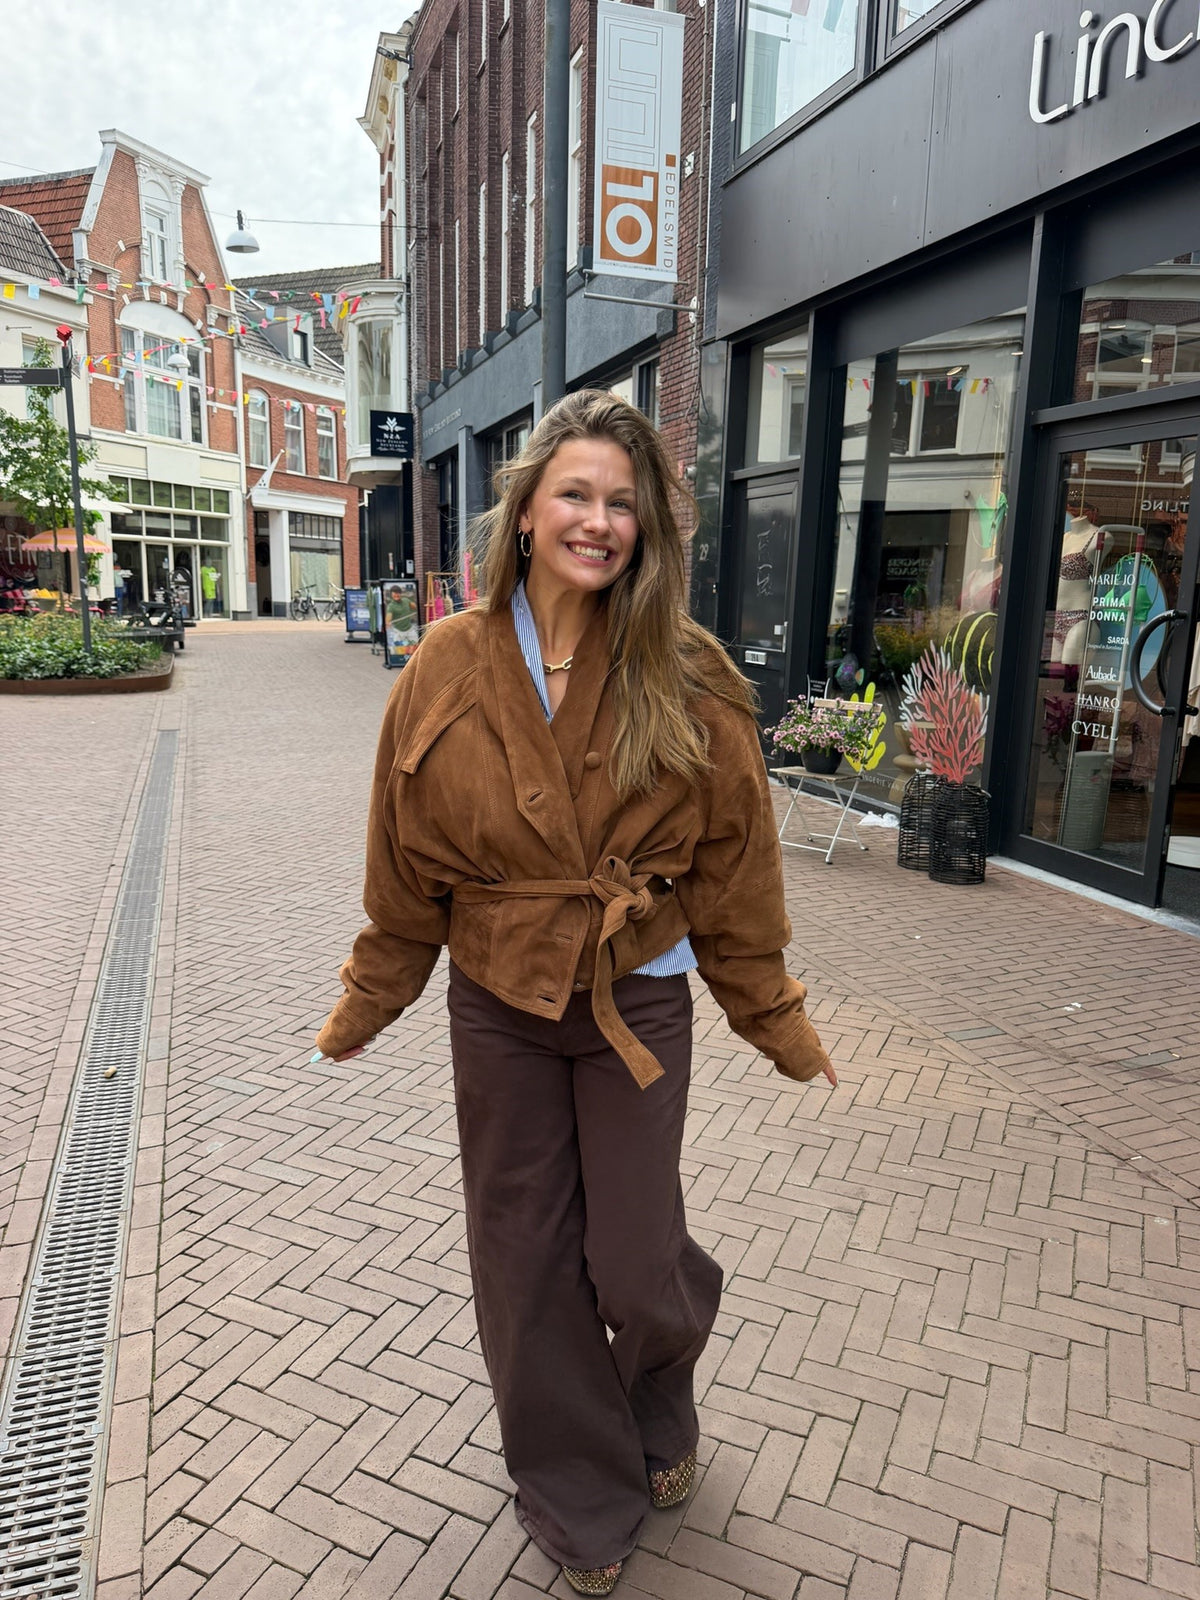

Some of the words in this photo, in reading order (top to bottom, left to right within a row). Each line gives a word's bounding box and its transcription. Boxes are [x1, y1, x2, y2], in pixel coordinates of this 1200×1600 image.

[1029, 0, 1200, 124] Linc
[664, 172, 677, 269] EDELSMID
[699, 543, 709, 560] 29
[1088, 573, 1120, 586] MARIE
[1122, 573, 1136, 586] JO
[1092, 596, 1127, 608] PRIMA
[1089, 610, 1126, 622] DONNA
[1107, 636, 1130, 646] SARDA
[1085, 664, 1117, 682] Aubade
[1077, 692, 1120, 710] HANRO
[1071, 719, 1119, 741] CYELL
